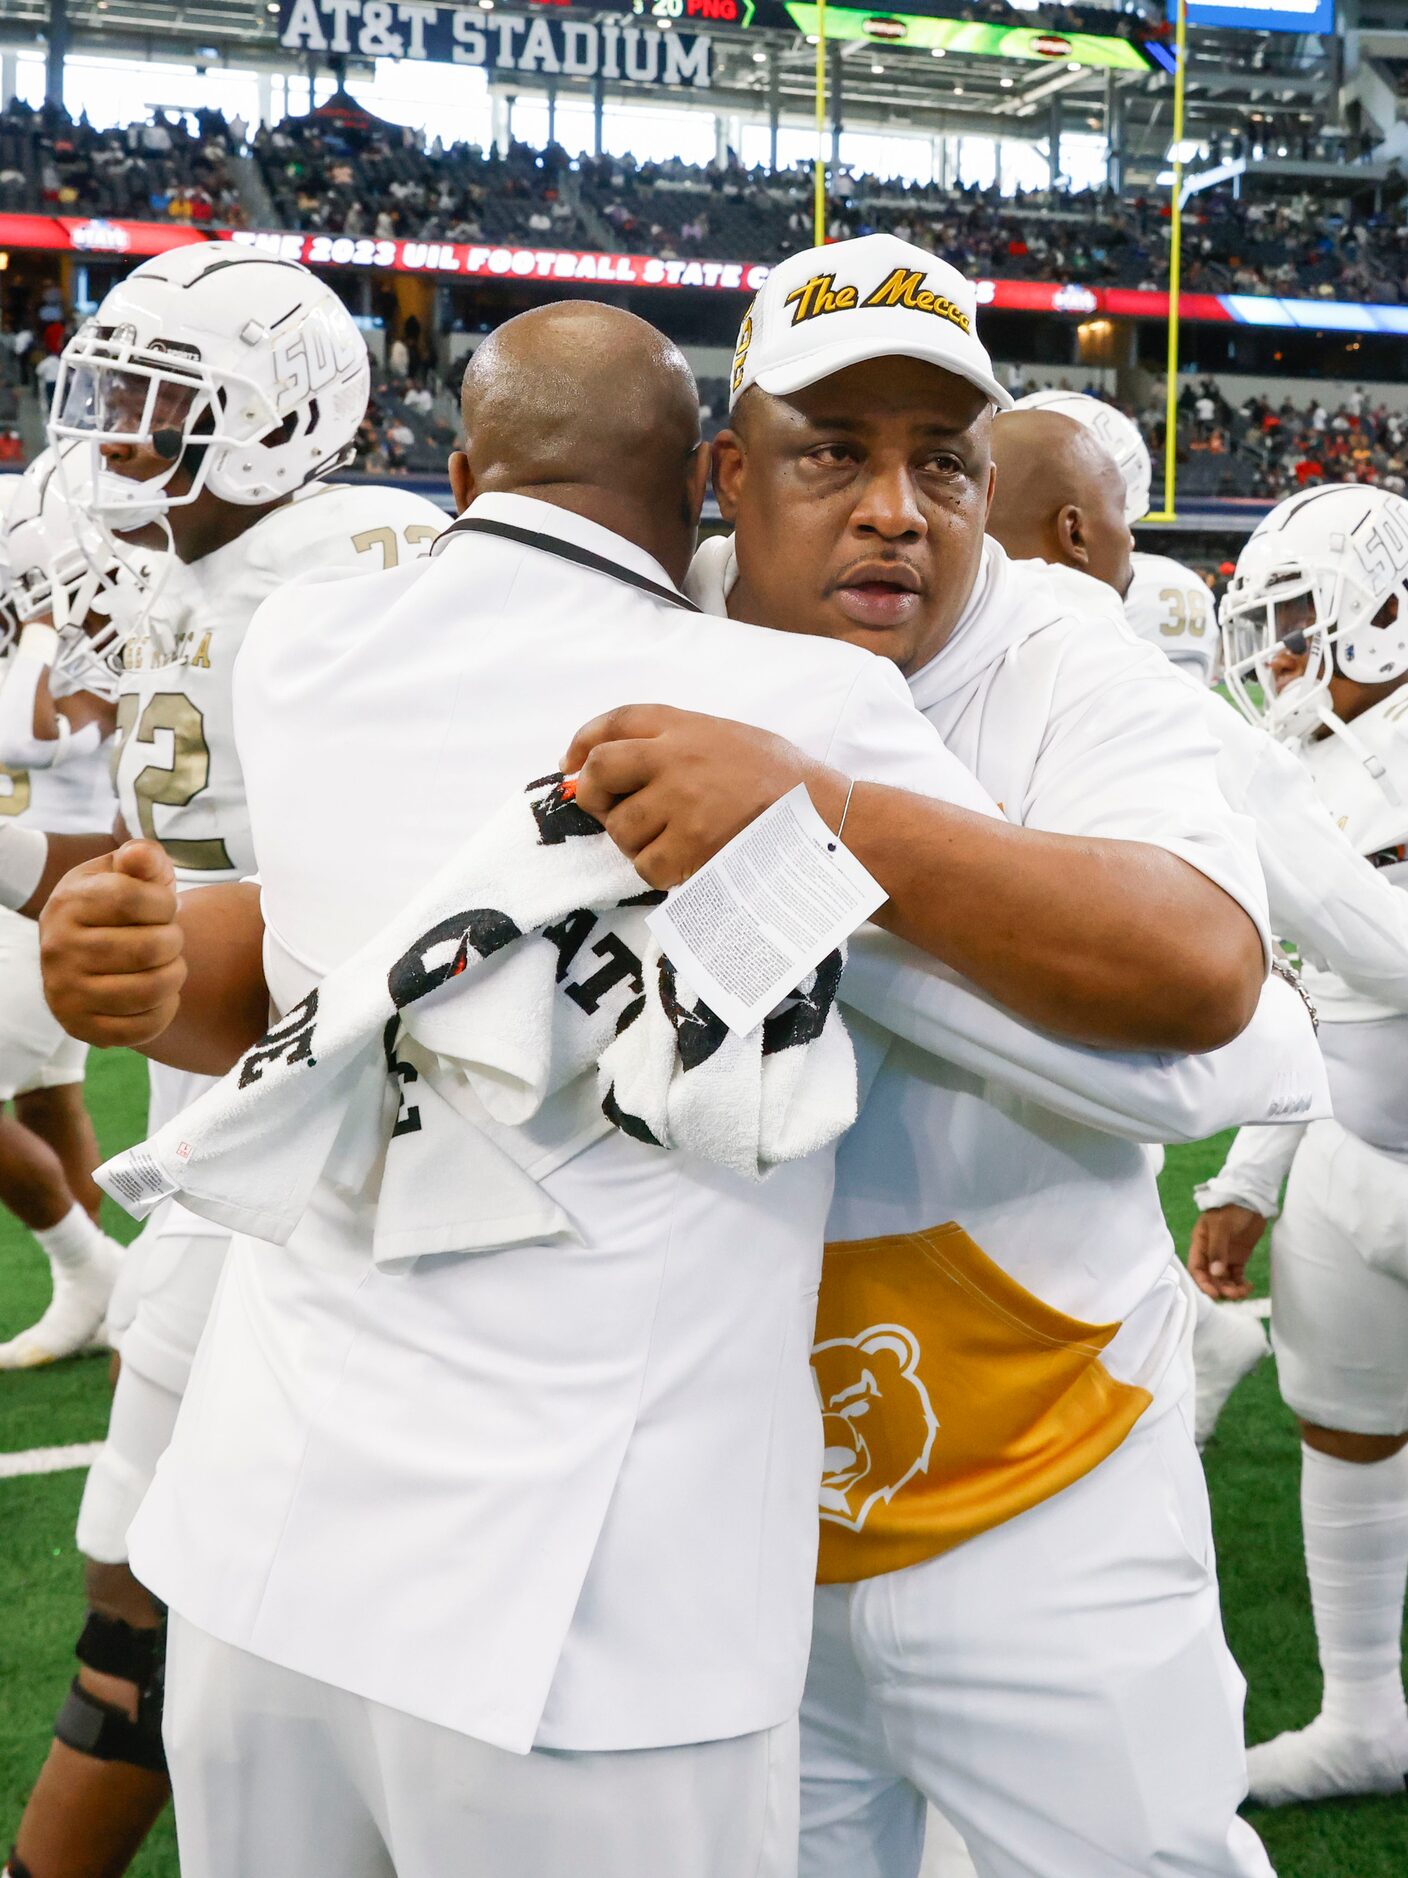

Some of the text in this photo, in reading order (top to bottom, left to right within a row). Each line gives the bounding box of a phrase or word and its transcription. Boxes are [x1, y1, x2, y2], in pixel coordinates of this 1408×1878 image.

[280, 0, 712, 88] AT&T STADIUM
[309, 237, 397, 267] 2023
[402, 243, 460, 271] UIL
[467, 247, 637, 282] FOOTBALL
[642, 258, 743, 289] STATE
[784, 273, 859, 327] The
[860, 268, 972, 336] Mecca
